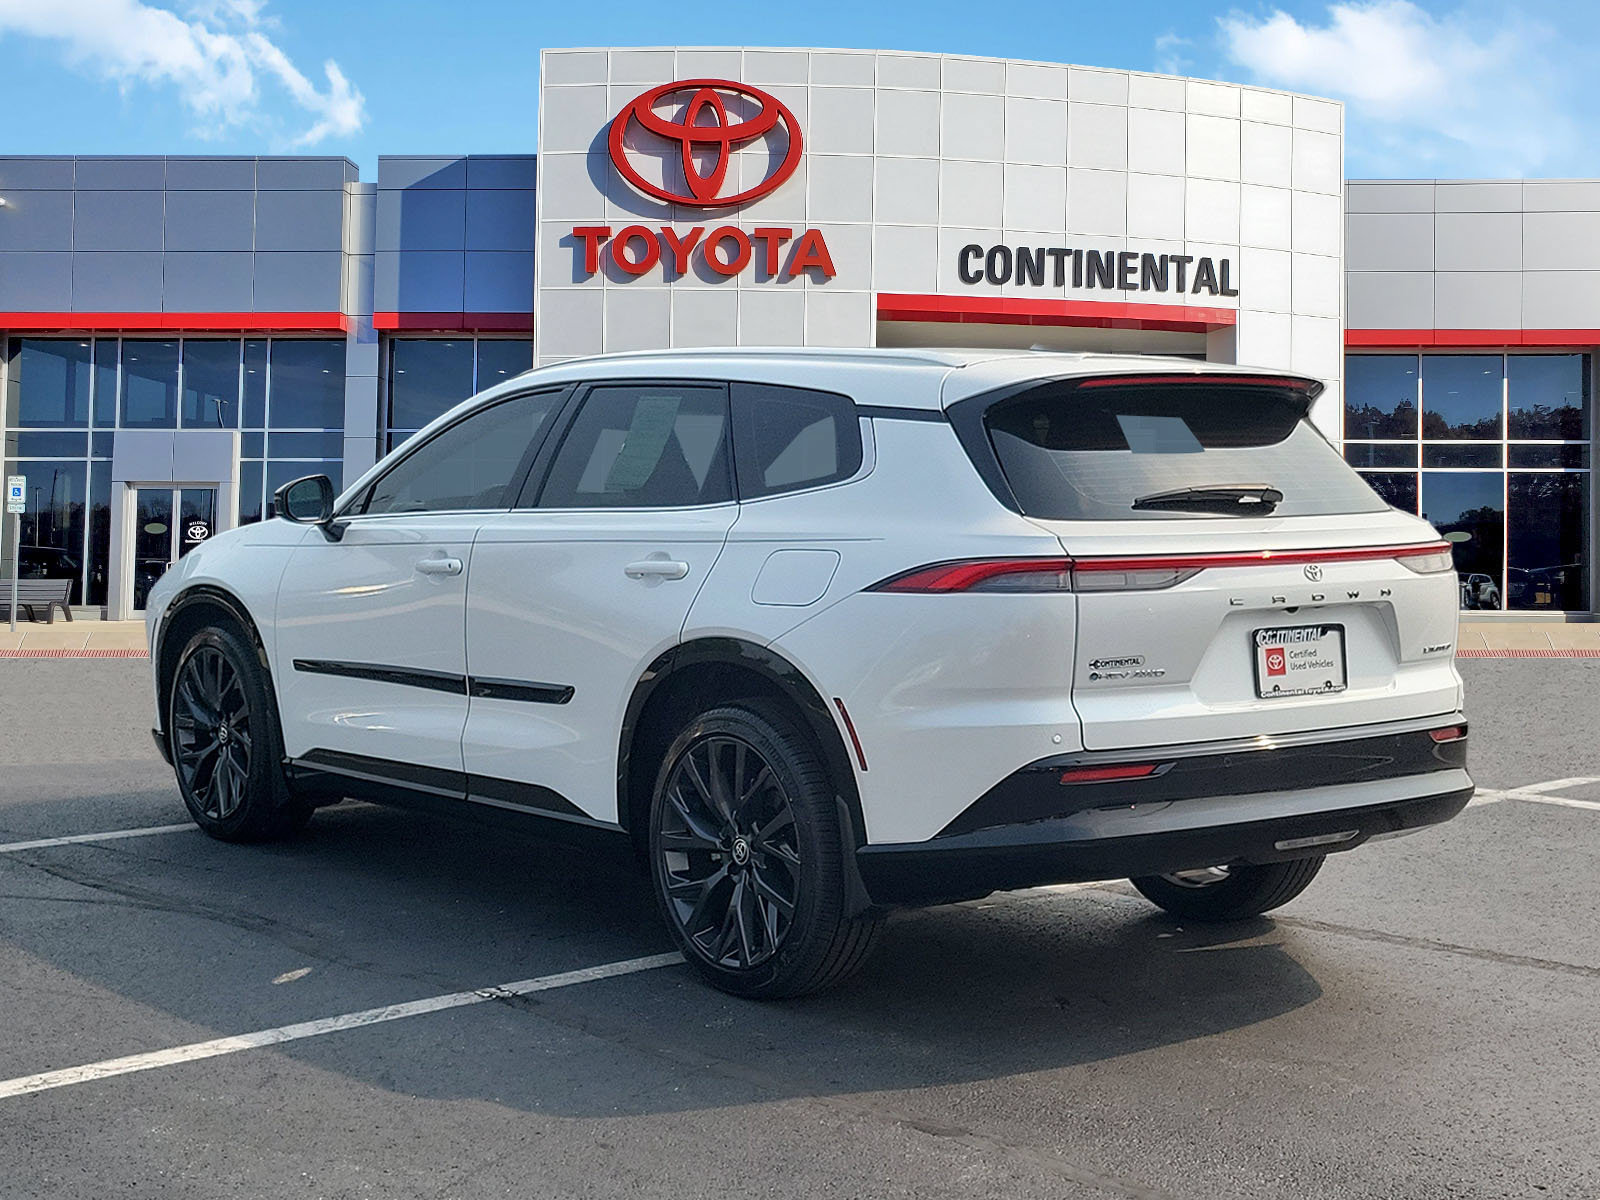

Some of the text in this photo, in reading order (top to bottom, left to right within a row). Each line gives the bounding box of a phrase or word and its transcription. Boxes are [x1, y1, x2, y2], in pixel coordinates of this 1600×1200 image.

[572, 225, 837, 278] TOYOTA
[957, 244, 1239, 297] CONTINENTAL
[1289, 649, 1317, 660] Certified
[1290, 660, 1334, 671] Used Vehicles
